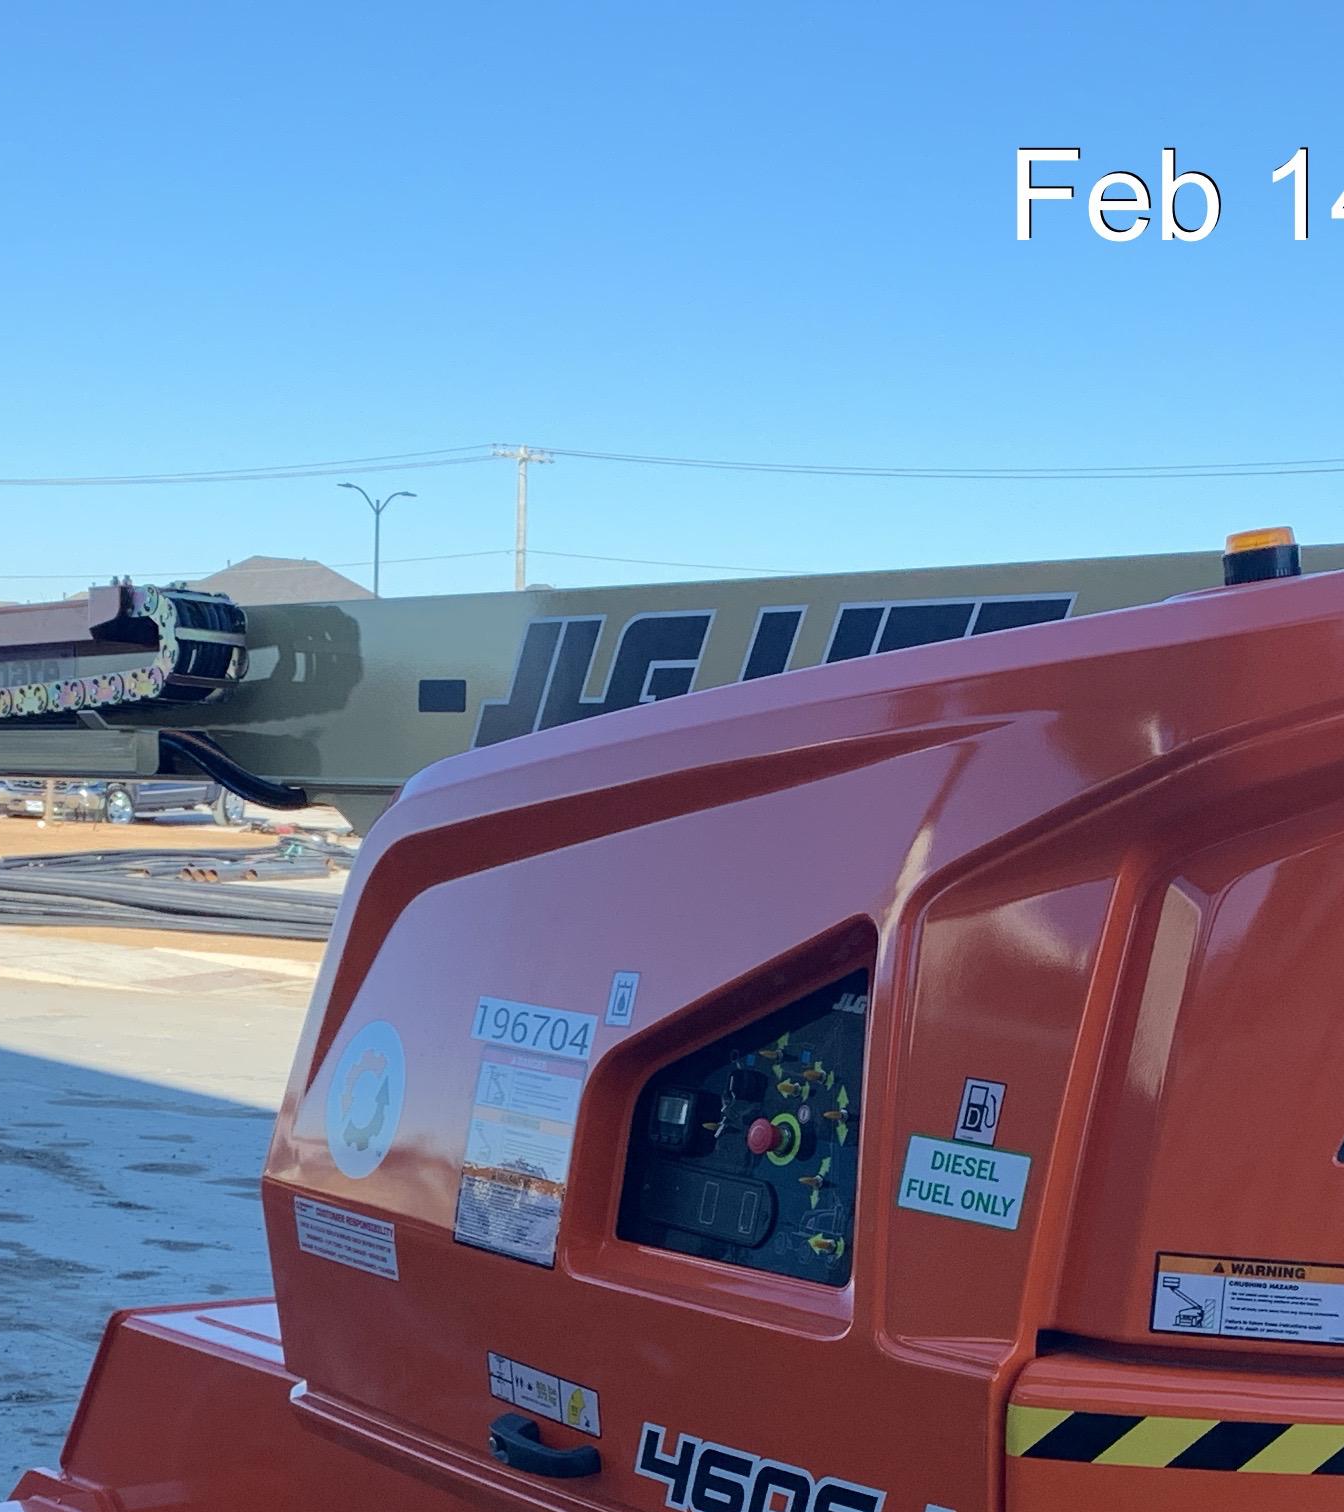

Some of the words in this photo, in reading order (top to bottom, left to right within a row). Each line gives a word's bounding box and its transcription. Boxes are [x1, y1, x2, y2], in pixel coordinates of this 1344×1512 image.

[832, 992, 868, 1015] JLG
[477, 1004, 590, 1056] 196704
[930, 1149, 1000, 1183] DIESEL
[906, 1177, 954, 1207] FUEL
[960, 1188, 1016, 1218] ONLY
[1231, 1262, 1307, 1280] WARNING
